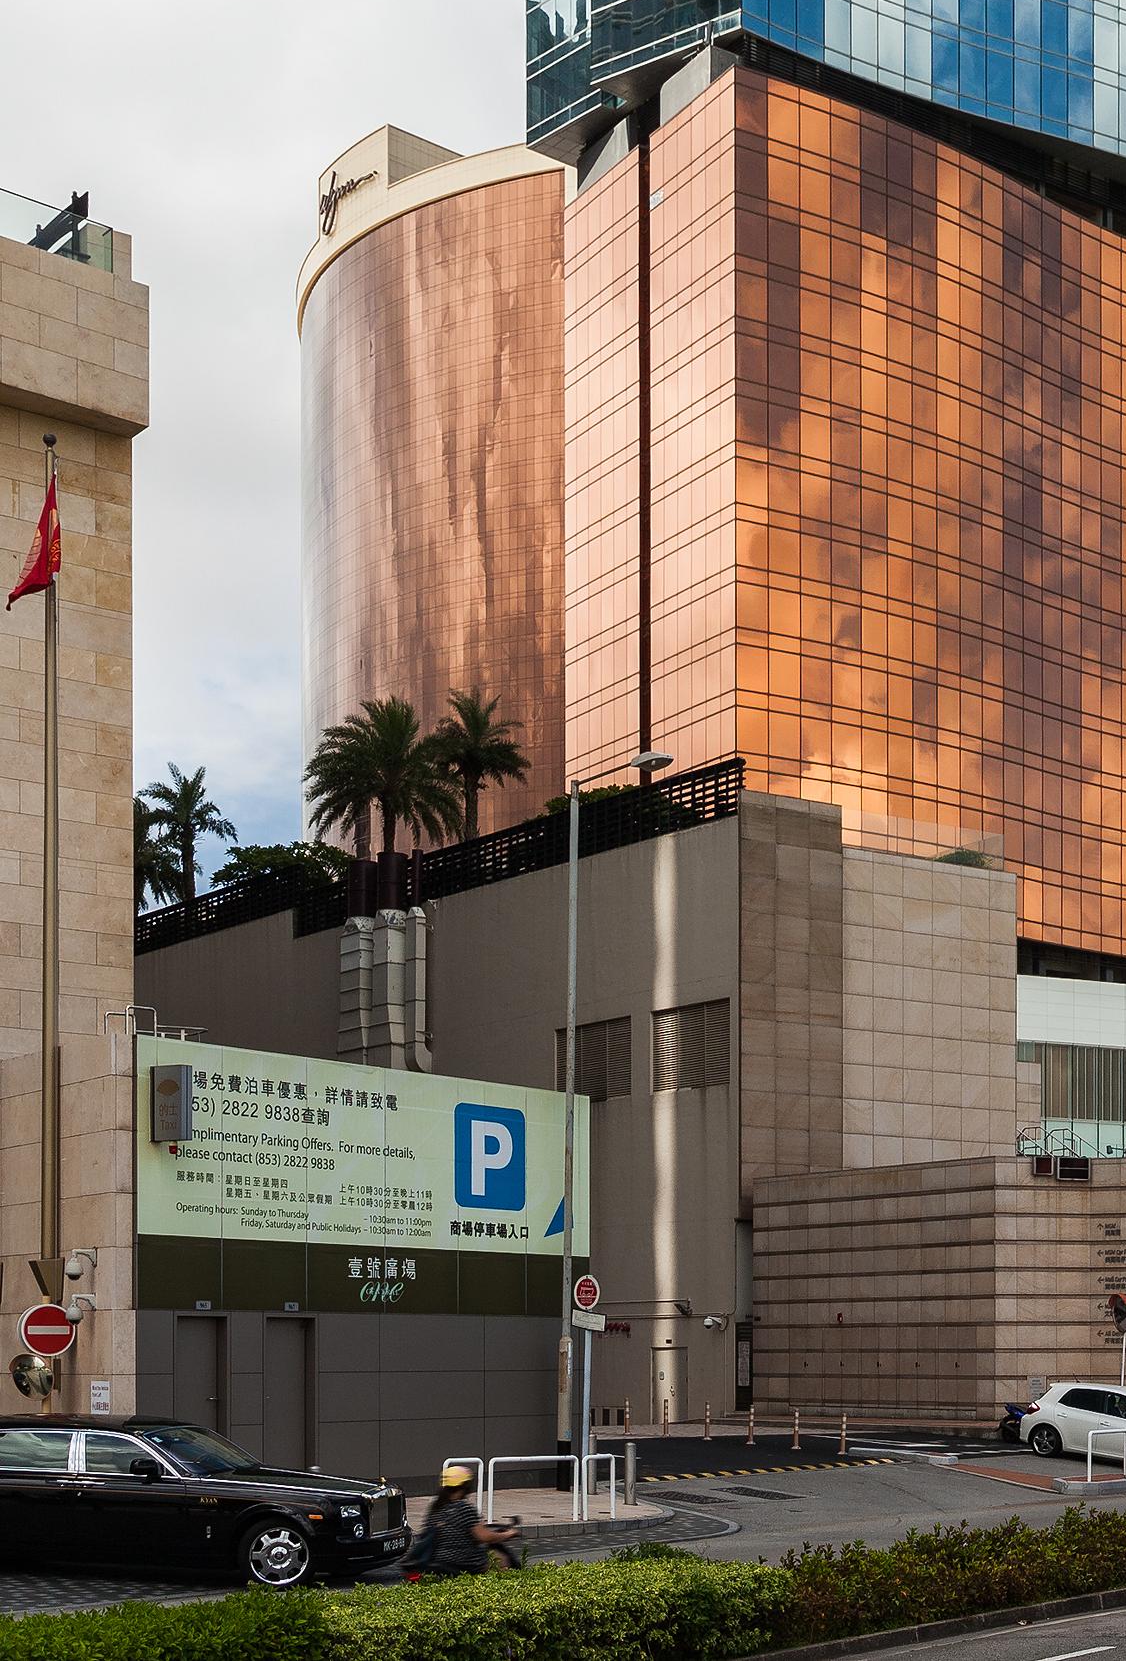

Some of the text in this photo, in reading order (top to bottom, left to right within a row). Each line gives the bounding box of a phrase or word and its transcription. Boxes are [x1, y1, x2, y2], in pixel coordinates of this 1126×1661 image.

[192, 1070, 398, 1111] 場免費泊車優惠，詳情請致電
[191, 1096, 330, 1126] 53) 2822 9838查詢
[191, 1127, 416, 1161] mplimentary Parking Offers. For more details,
[175, 1145, 335, 1170] please contact (853) 2822 9838
[471, 1119, 513, 1197] P
[225, 1174, 288, 1189] 星期日至星期四
[339, 1183, 433, 1200] 上午10時30分至晚上11時
[175, 1201, 213, 1215] Operating
[215, 1205, 238, 1215] hours:
[241, 1206, 267, 1218] Sunday
[277, 1209, 309, 1221] Thursday
[397, 1217, 404, 1226] to
[240, 1218, 264, 1230] Friday,
[265, 1220, 296, 1232] Saturday
[297, 1221, 311, 1231] and
[312, 1222, 333, 1232] Public
[334, 1223, 362, 1235] Holidays
[397, 1227, 404, 1236] to
[450, 1220, 529, 1240] 商場停車場入口
